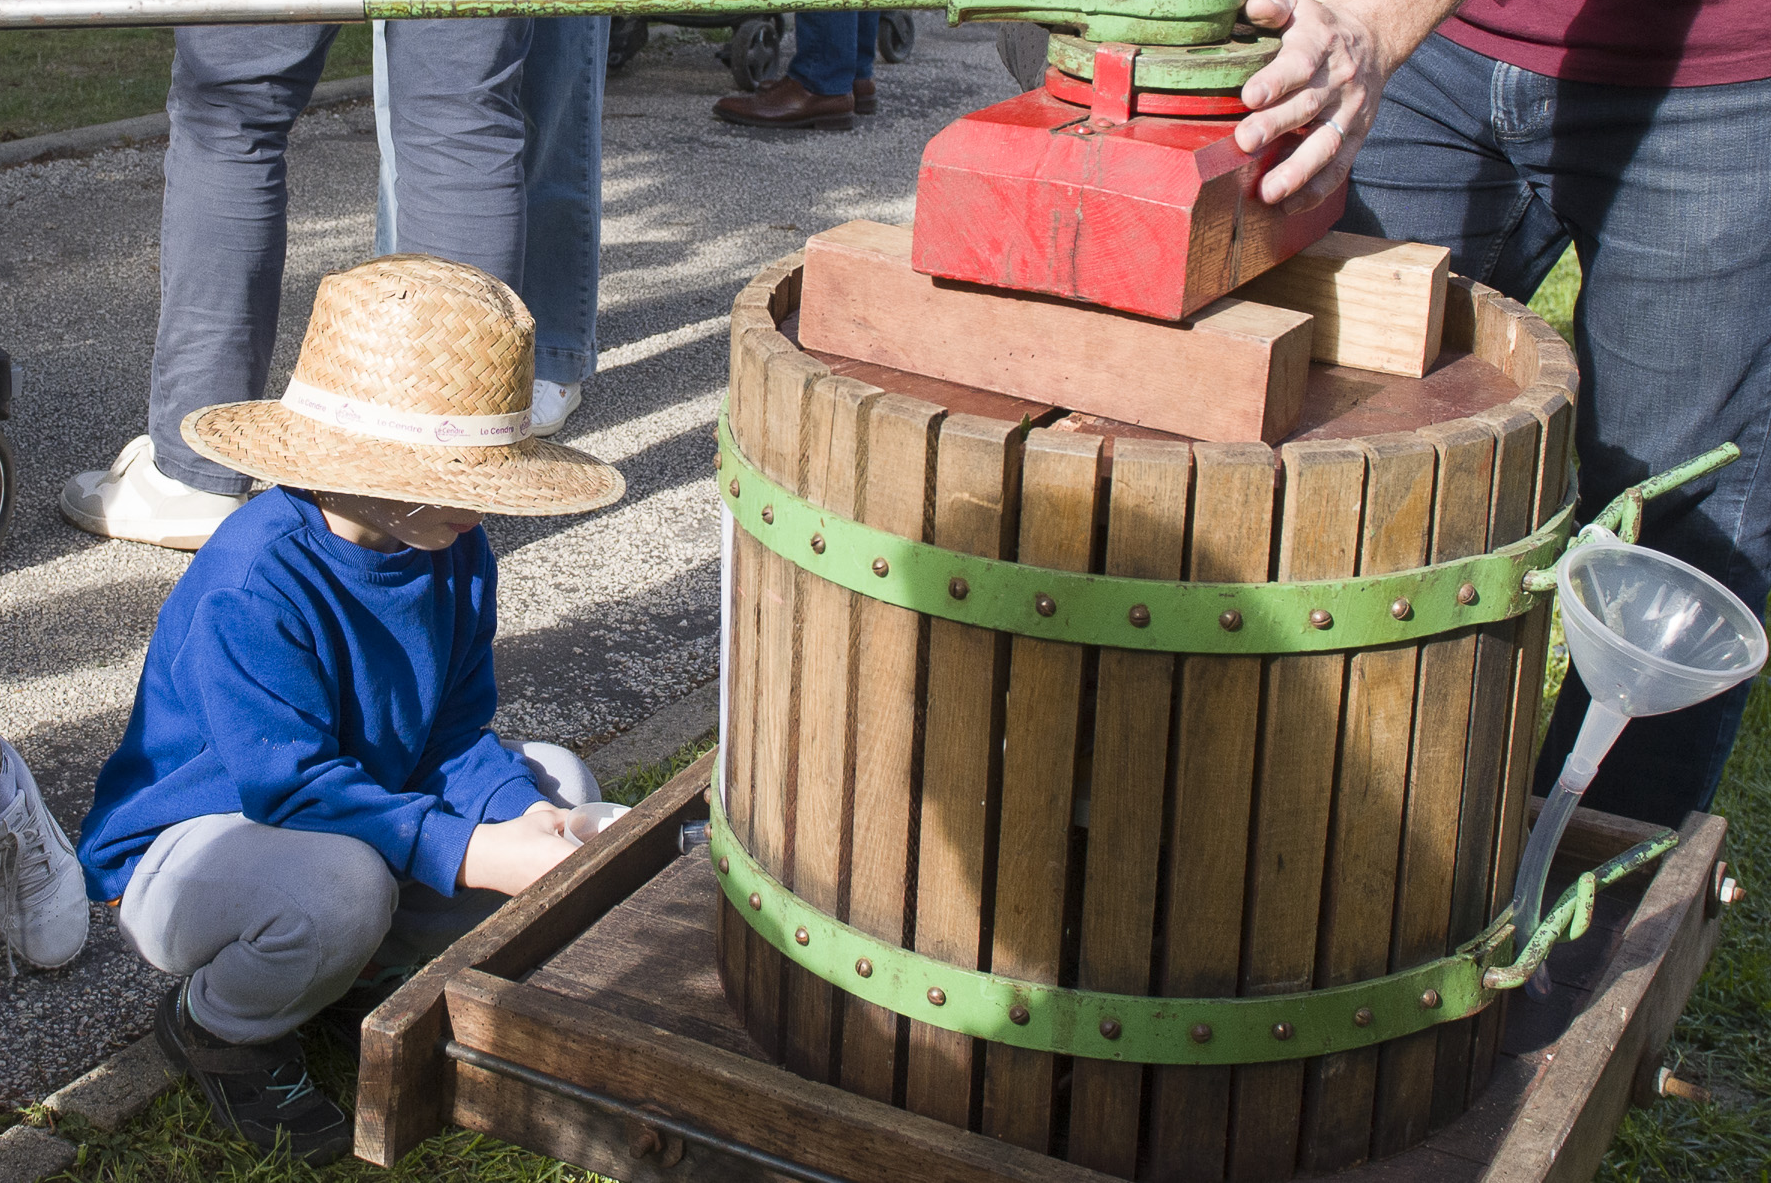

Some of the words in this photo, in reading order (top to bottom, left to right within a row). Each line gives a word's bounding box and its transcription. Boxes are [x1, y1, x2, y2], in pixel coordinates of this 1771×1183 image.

[297, 396, 305, 406] Le
[305, 399, 327, 413] Cendre
[388, 420, 423, 434] Cendre
[480, 427, 489, 436] Le
[490, 426, 515, 435] Cendre
